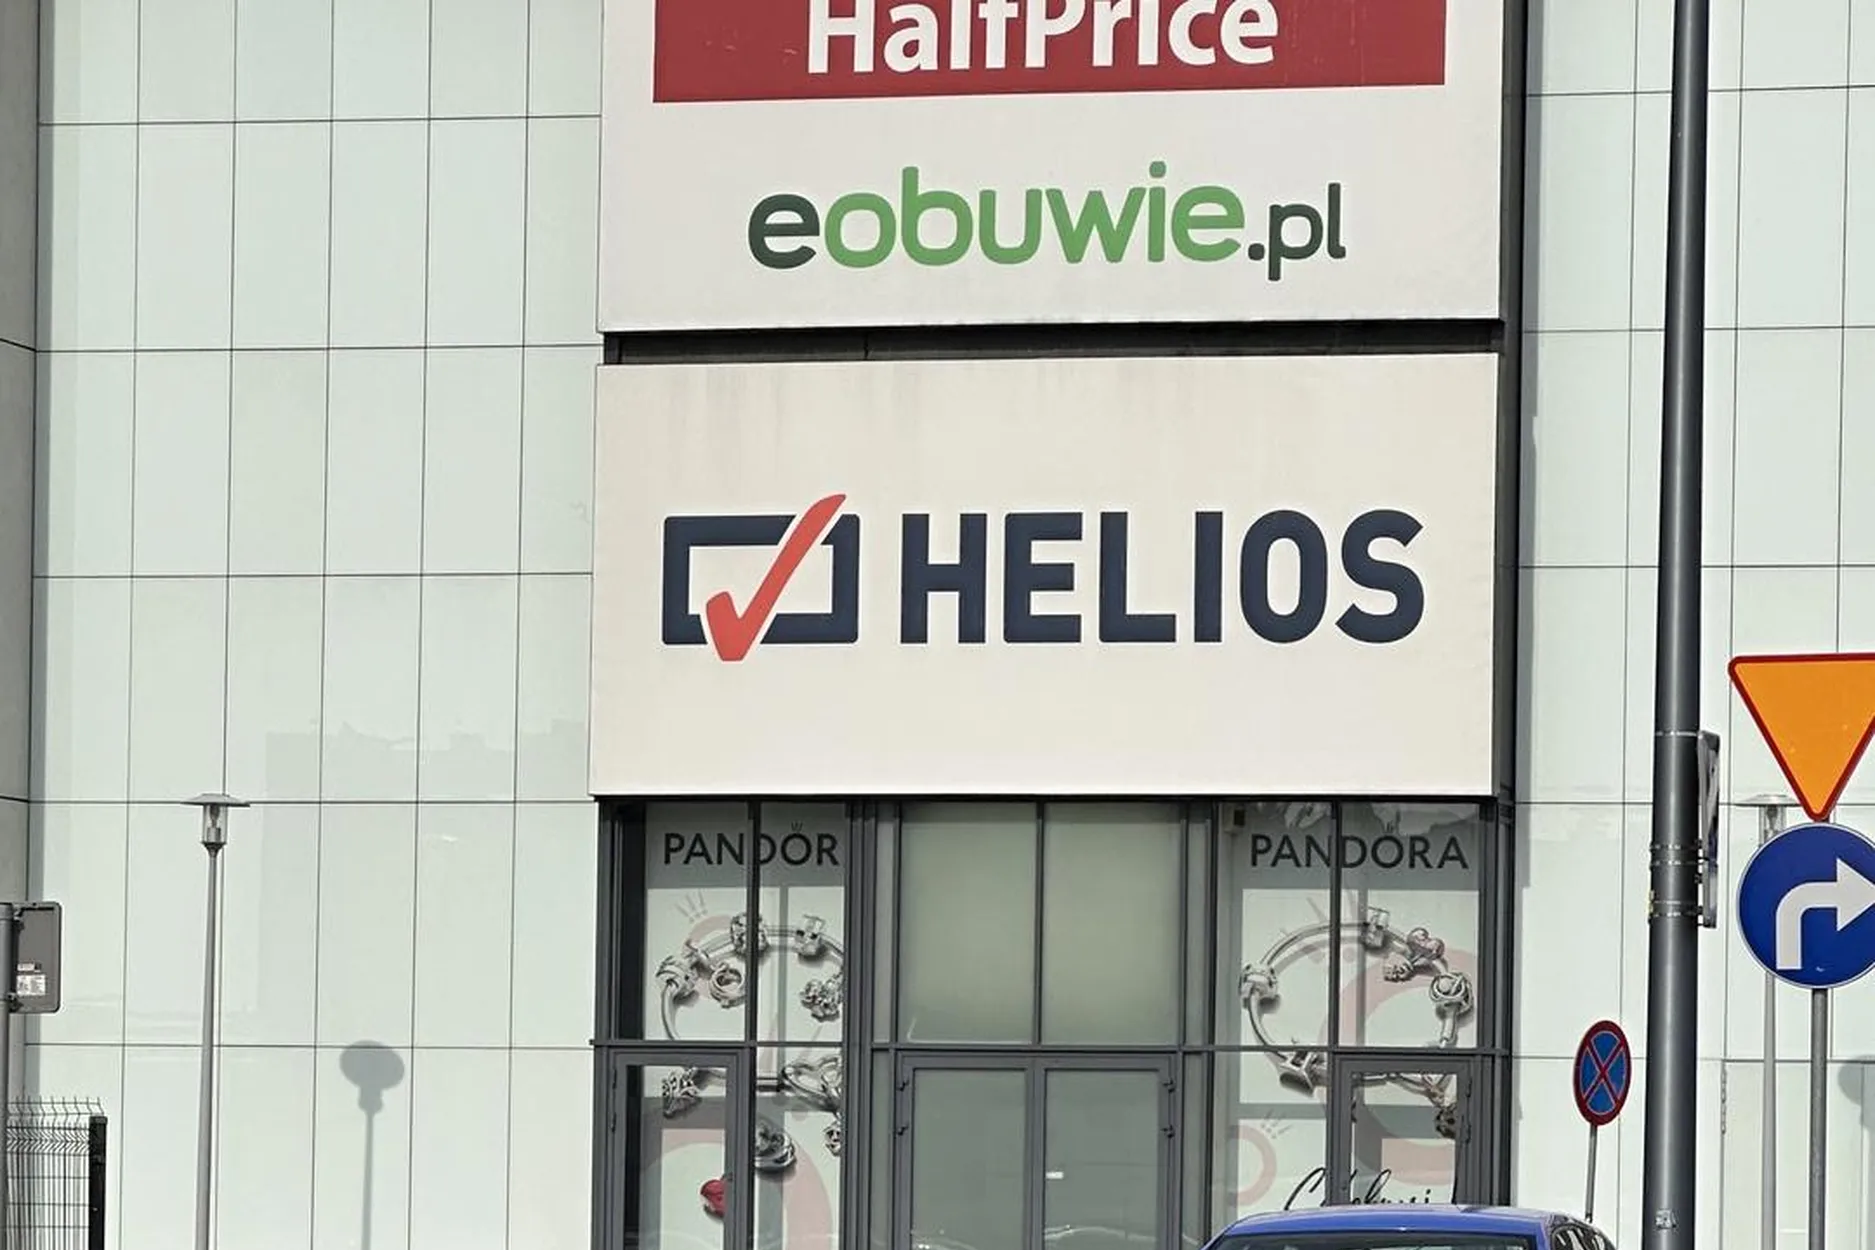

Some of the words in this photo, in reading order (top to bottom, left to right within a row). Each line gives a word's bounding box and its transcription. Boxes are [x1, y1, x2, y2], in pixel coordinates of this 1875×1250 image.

[808, 0, 1279, 74] HalfPrice
[748, 160, 1346, 282] eobuwie.pl
[900, 509, 1425, 644] HELIOS
[664, 833, 839, 865] PANDOR
[1251, 834, 1469, 869] PANDORA
